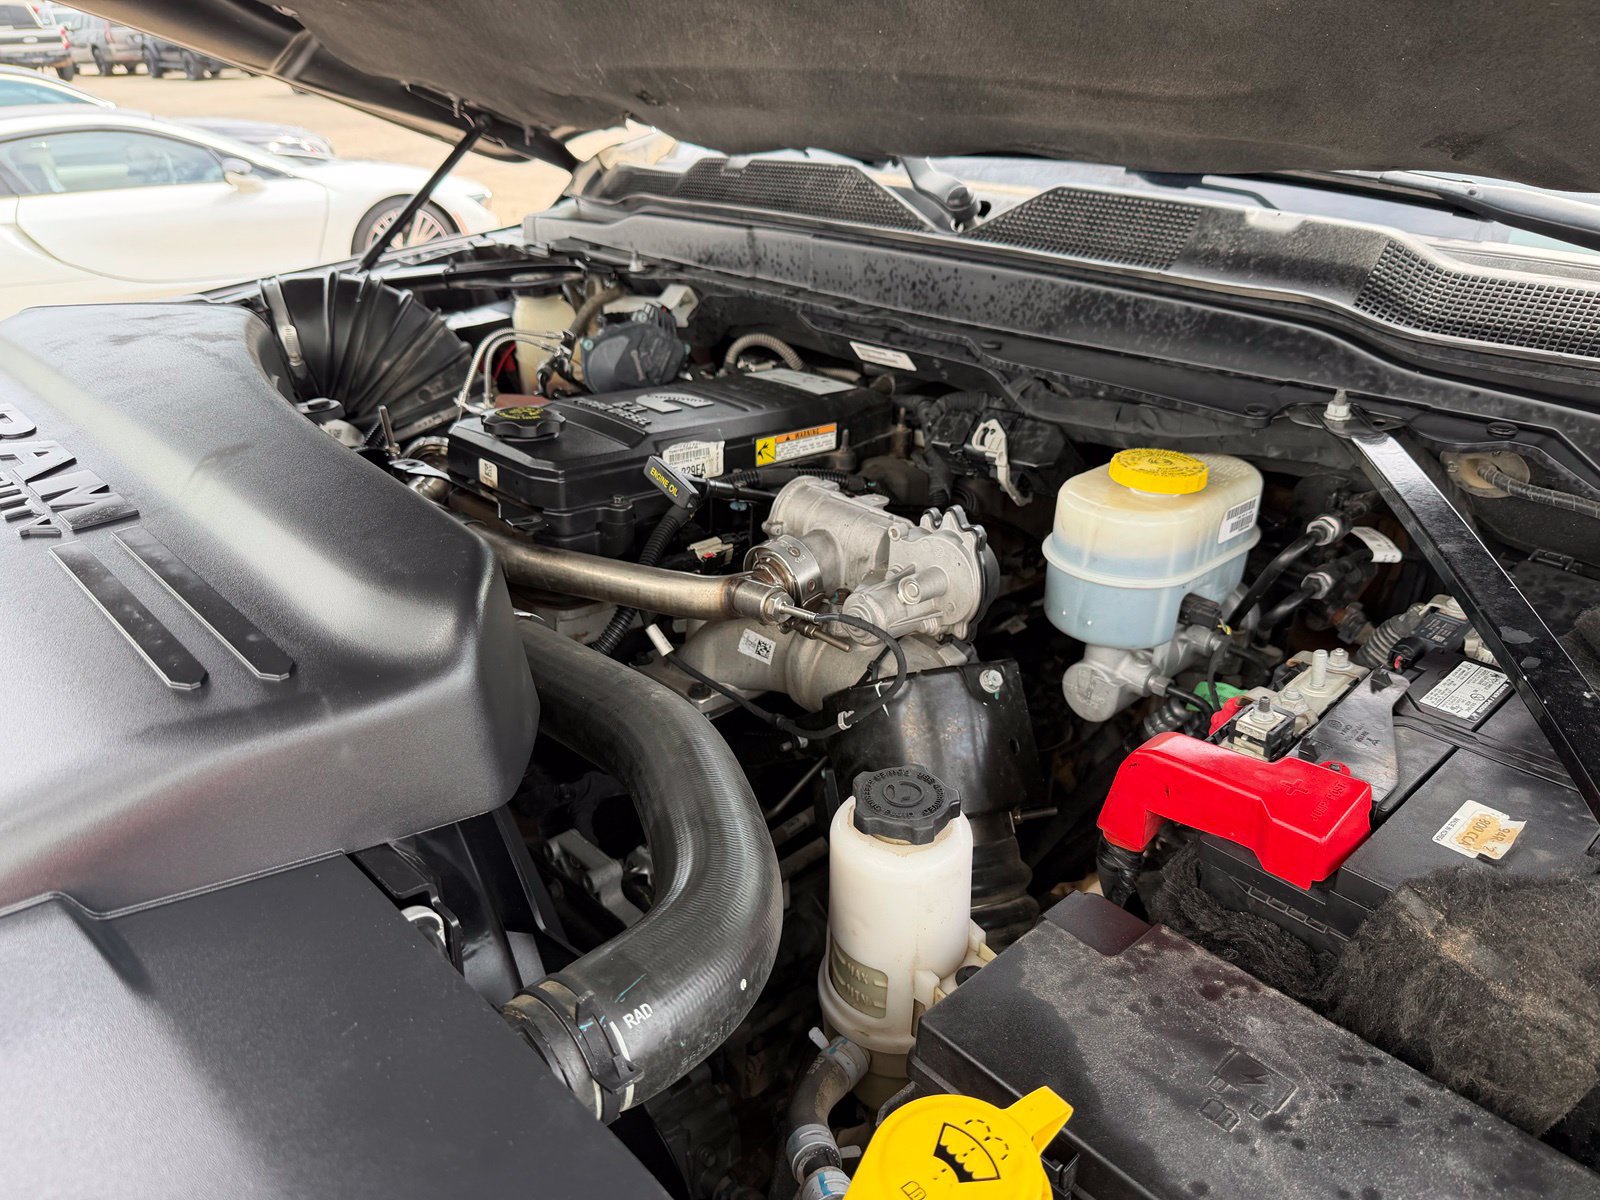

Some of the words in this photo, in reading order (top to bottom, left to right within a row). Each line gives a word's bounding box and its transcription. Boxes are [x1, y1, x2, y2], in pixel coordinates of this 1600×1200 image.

[794, 428, 820, 439] WARNING
[650, 467, 671, 489] ENGINE
[668, 484, 680, 498] OIL
[1326, 781, 1348, 801] POST
[1473, 818, 1491, 832] 800
[1458, 831, 1479, 848] CCA
[622, 1003, 654, 1030] RAD
